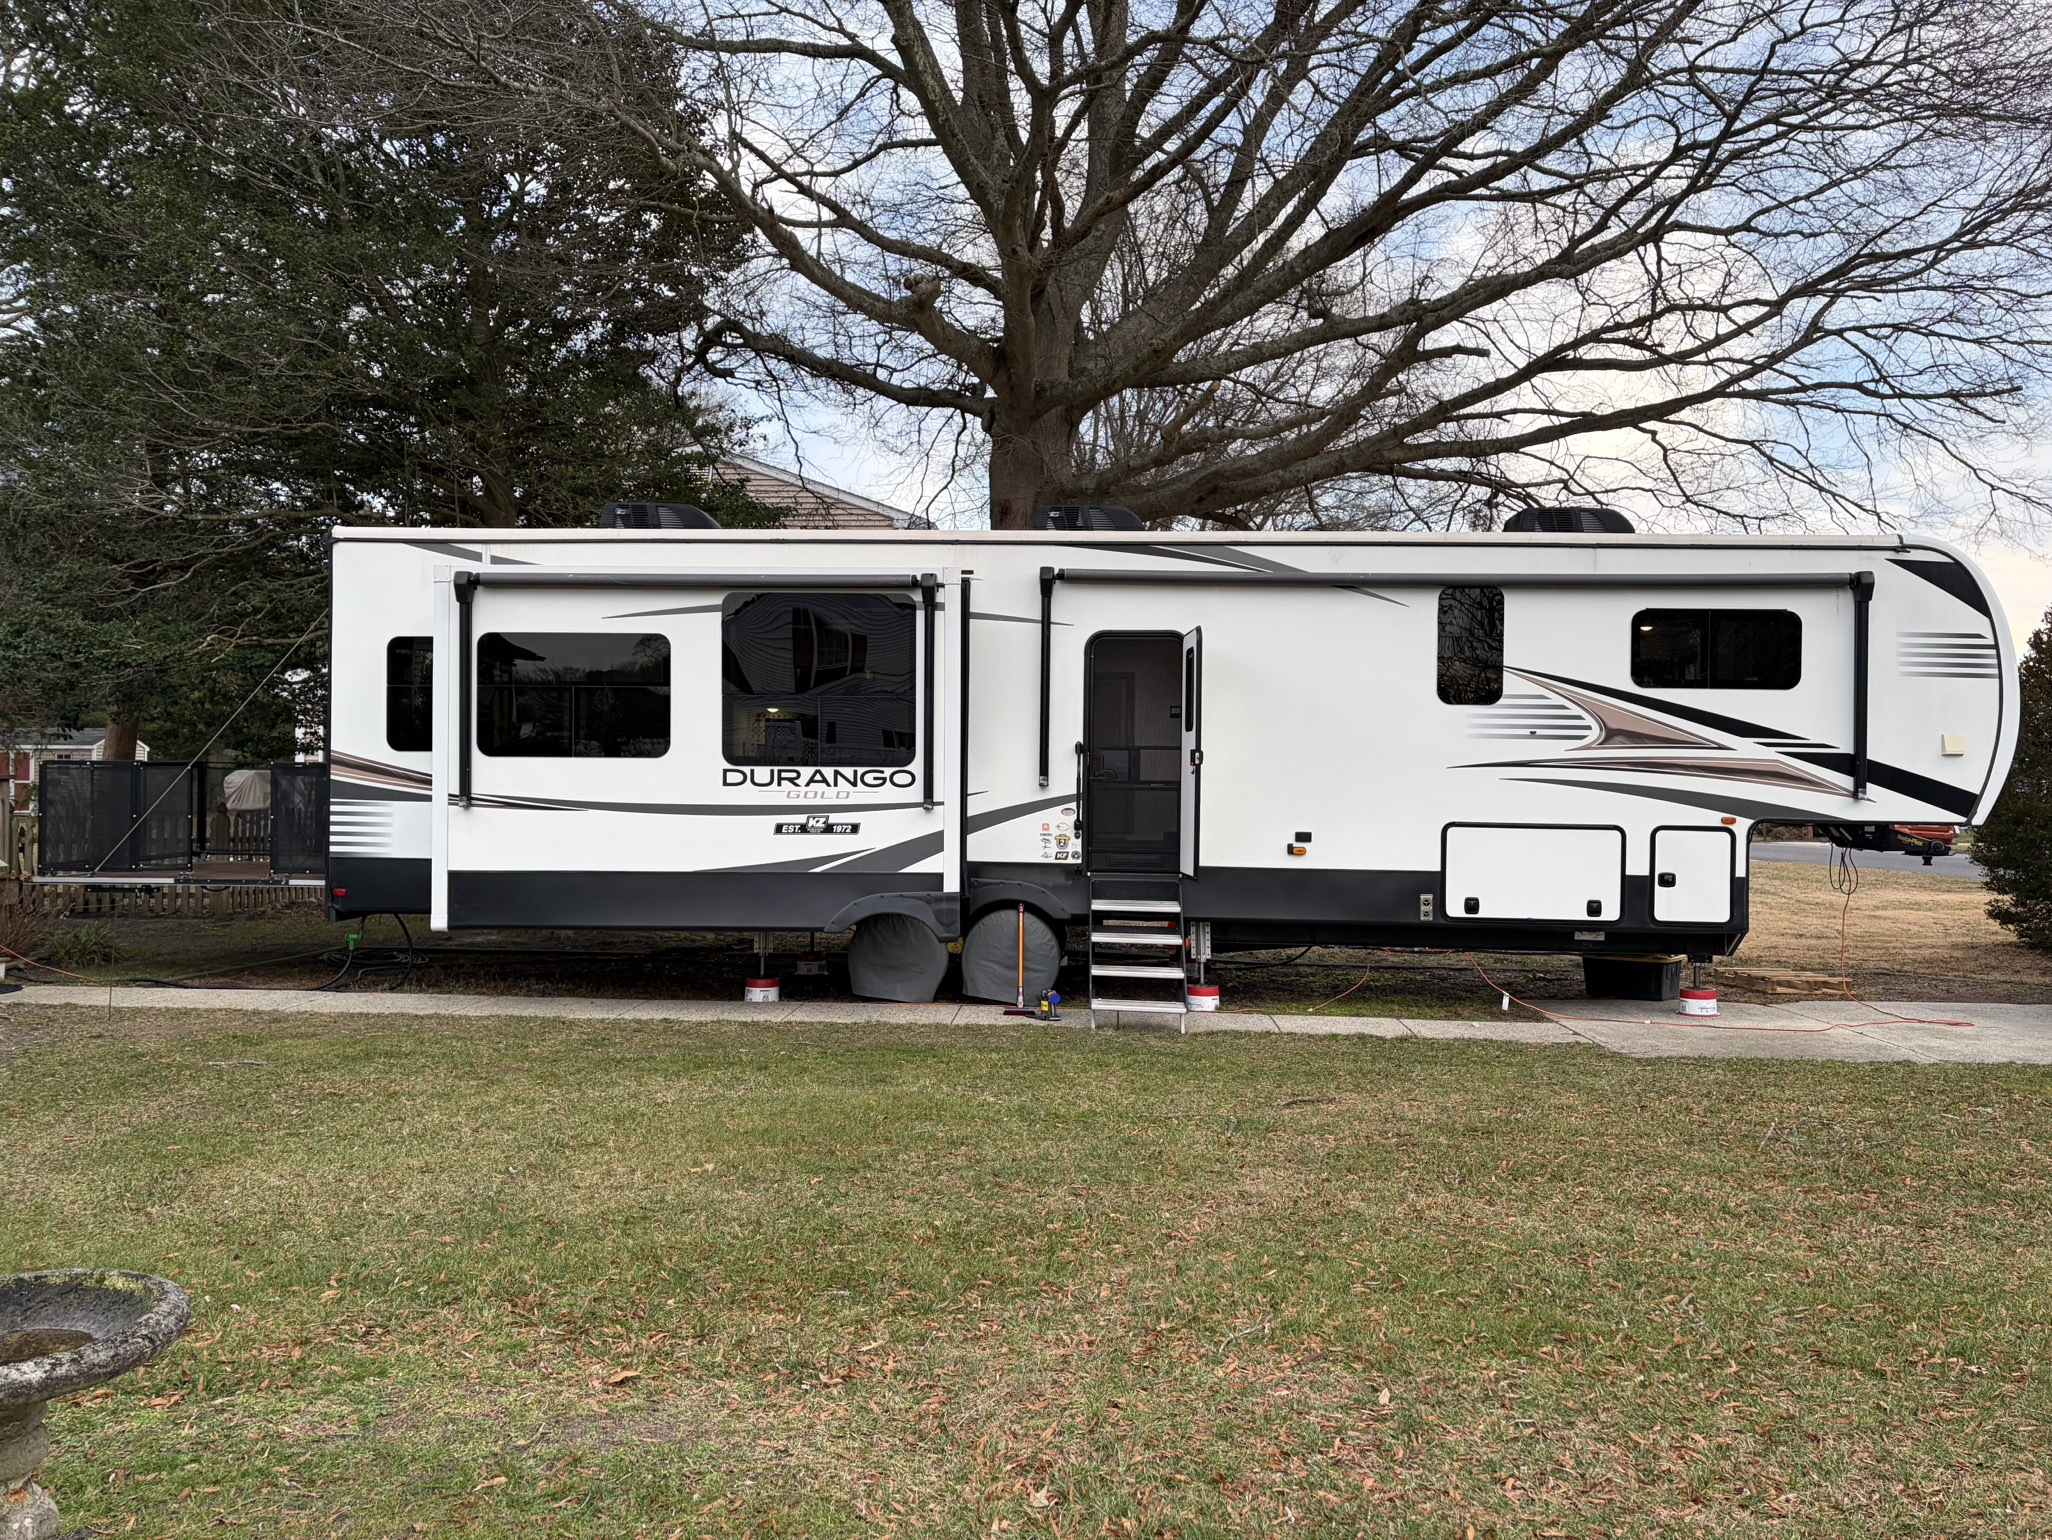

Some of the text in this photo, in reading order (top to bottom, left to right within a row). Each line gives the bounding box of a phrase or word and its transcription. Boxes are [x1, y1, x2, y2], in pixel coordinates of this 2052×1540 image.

[722, 768, 916, 788] DURANGO
[786, 790, 850, 799] GOLD
[808, 817, 826, 827] KZ
[781, 825, 801, 833] EST.
[832, 825, 852, 833] 1972
